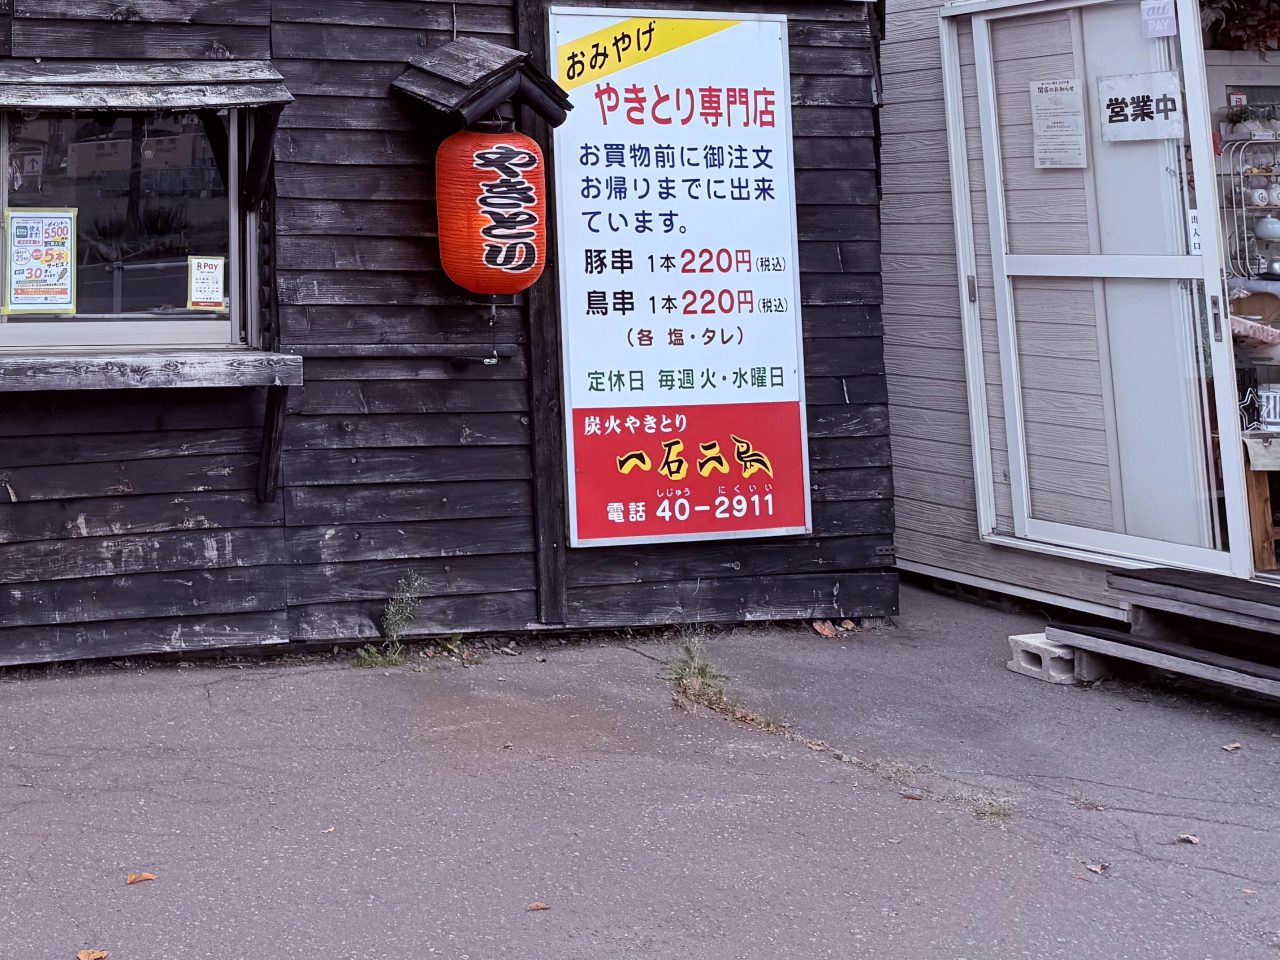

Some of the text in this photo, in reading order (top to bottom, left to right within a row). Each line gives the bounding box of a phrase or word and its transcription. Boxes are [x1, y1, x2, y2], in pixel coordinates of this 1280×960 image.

[566, 20, 656, 80] おみやげ
[594, 82, 776, 128] やきとり専門店
[1106, 94, 1177, 124] 営業中
[579, 143, 774, 169] お買物前に御注文
[580, 176, 776, 201] お帰りまでに出来
[473, 144, 539, 273] やきとり
[581, 210, 687, 234] ています。
[1191, 215, 1201, 250] 出入口
[203, 262, 219, 271] Pay
[584, 248, 633, 275] 豚串
[585, 289, 635, 316] 鳥串
[587, 370, 644, 392] 定休日
[584, 413, 687, 436] 炭火やきとり
[616, 434, 774, 481] 一石二鳥
[656, 487, 691, 497] しじゅう
[606, 493, 774, 523] 電話 40-2911
